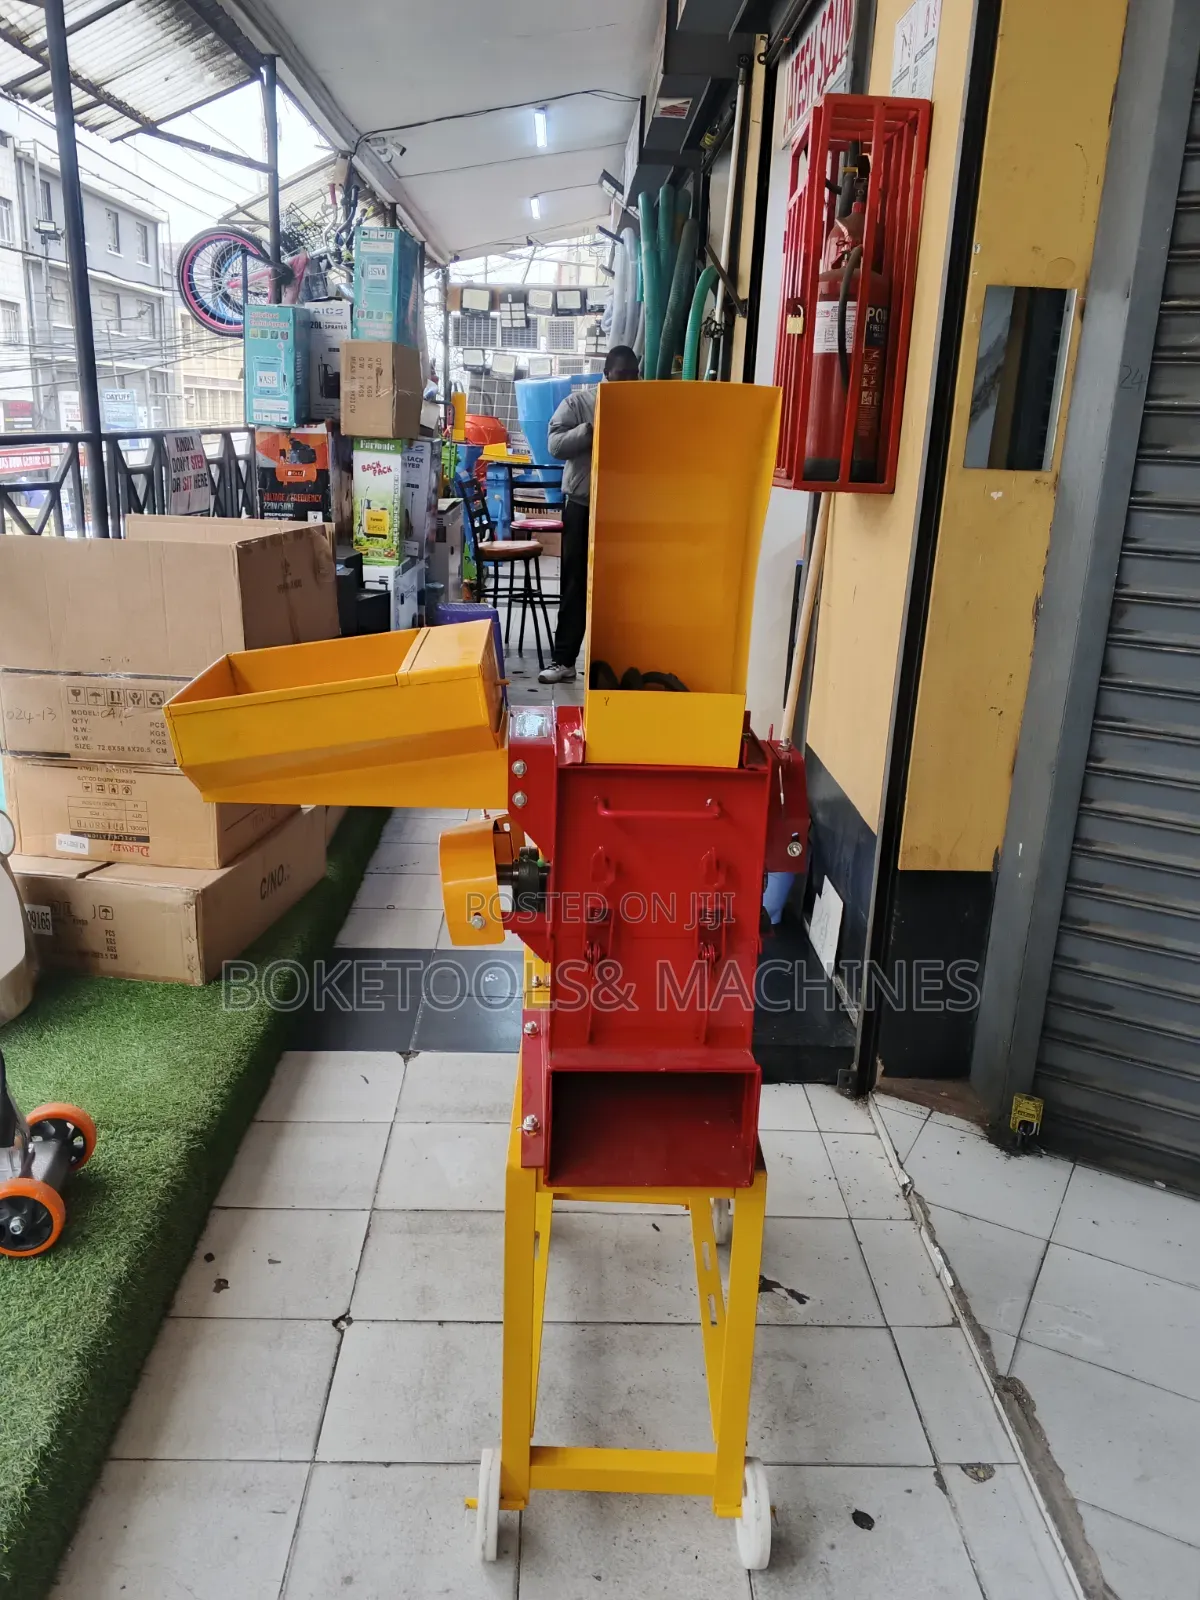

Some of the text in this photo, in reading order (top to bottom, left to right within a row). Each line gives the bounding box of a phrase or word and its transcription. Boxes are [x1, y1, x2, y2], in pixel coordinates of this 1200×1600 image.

[361, 461, 381, 472] BACK
[373, 466, 392, 476] PACK
[182, 475, 192, 491] SIT
[193, 473, 208, 489] HERE
[263, 493, 285, 501] VOLTAGE
[290, 493, 322, 502] FREQUENCY
[71, 709, 100, 717] MODEL:
